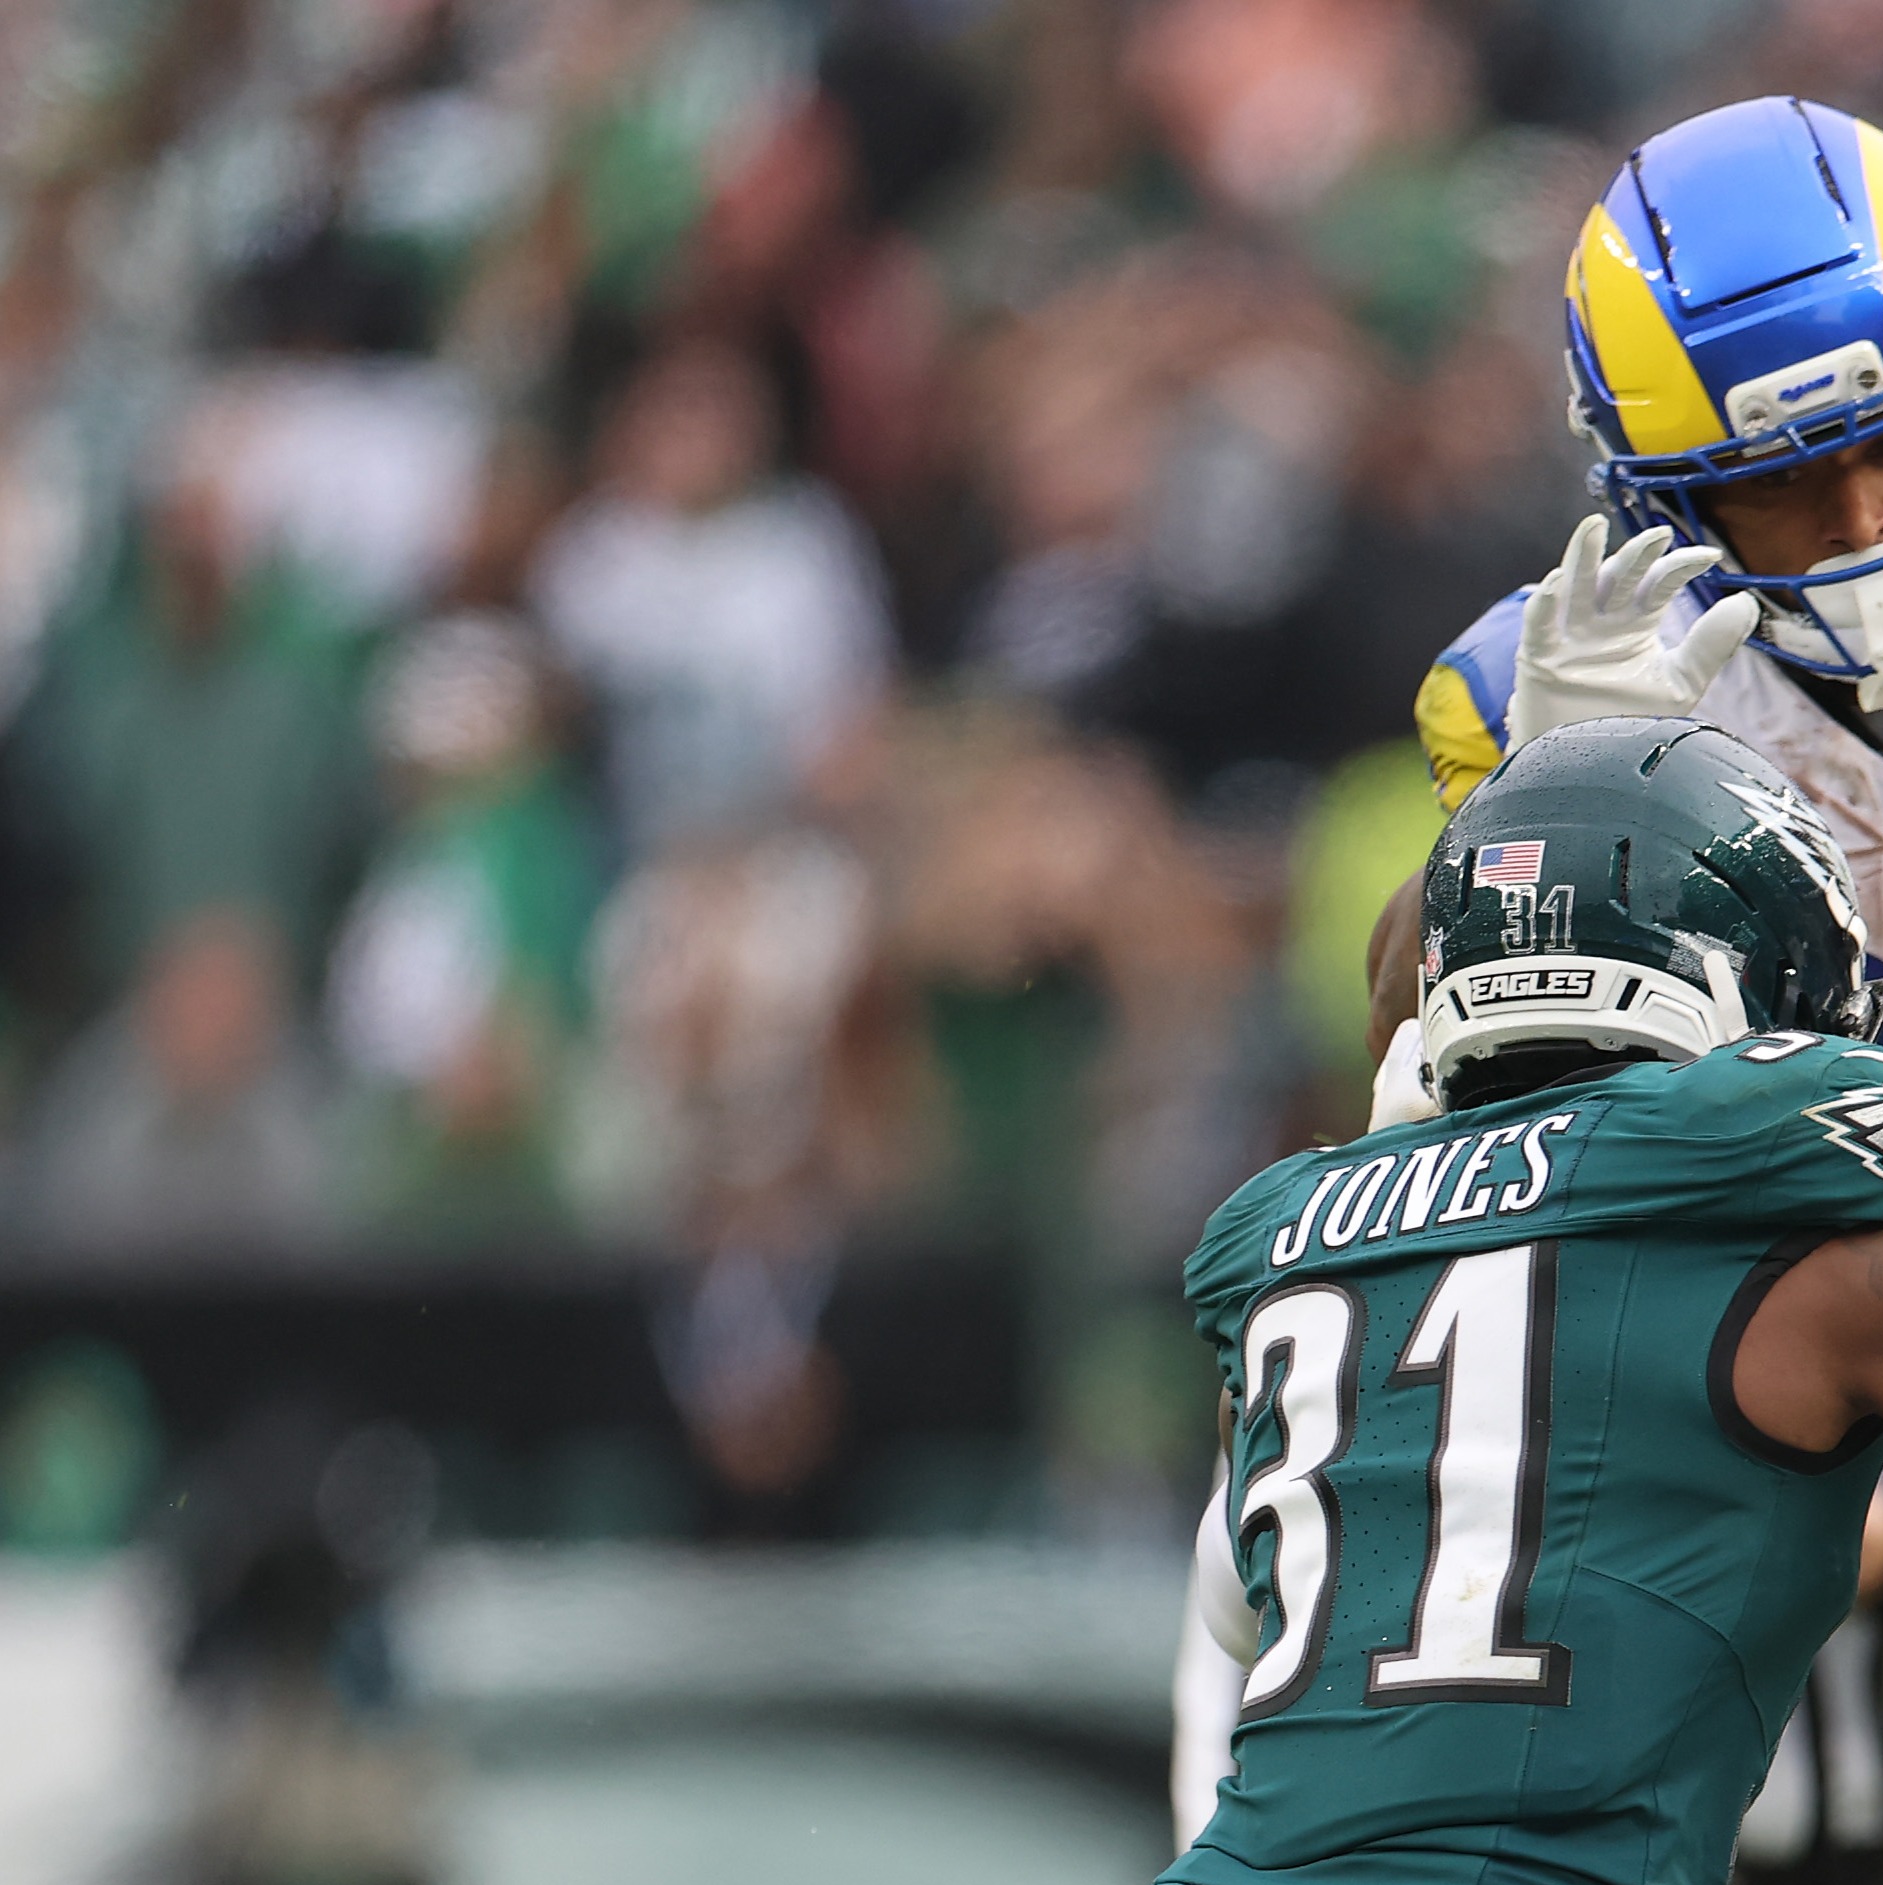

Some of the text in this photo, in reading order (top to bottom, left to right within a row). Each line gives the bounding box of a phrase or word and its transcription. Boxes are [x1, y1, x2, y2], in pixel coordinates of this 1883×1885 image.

[1500, 883, 1578, 955] 31
[1470, 971, 1594, 1003] EAGLES
[1270, 1111, 1579, 1271] JONES
[1236, 1240, 1573, 1723] 31
